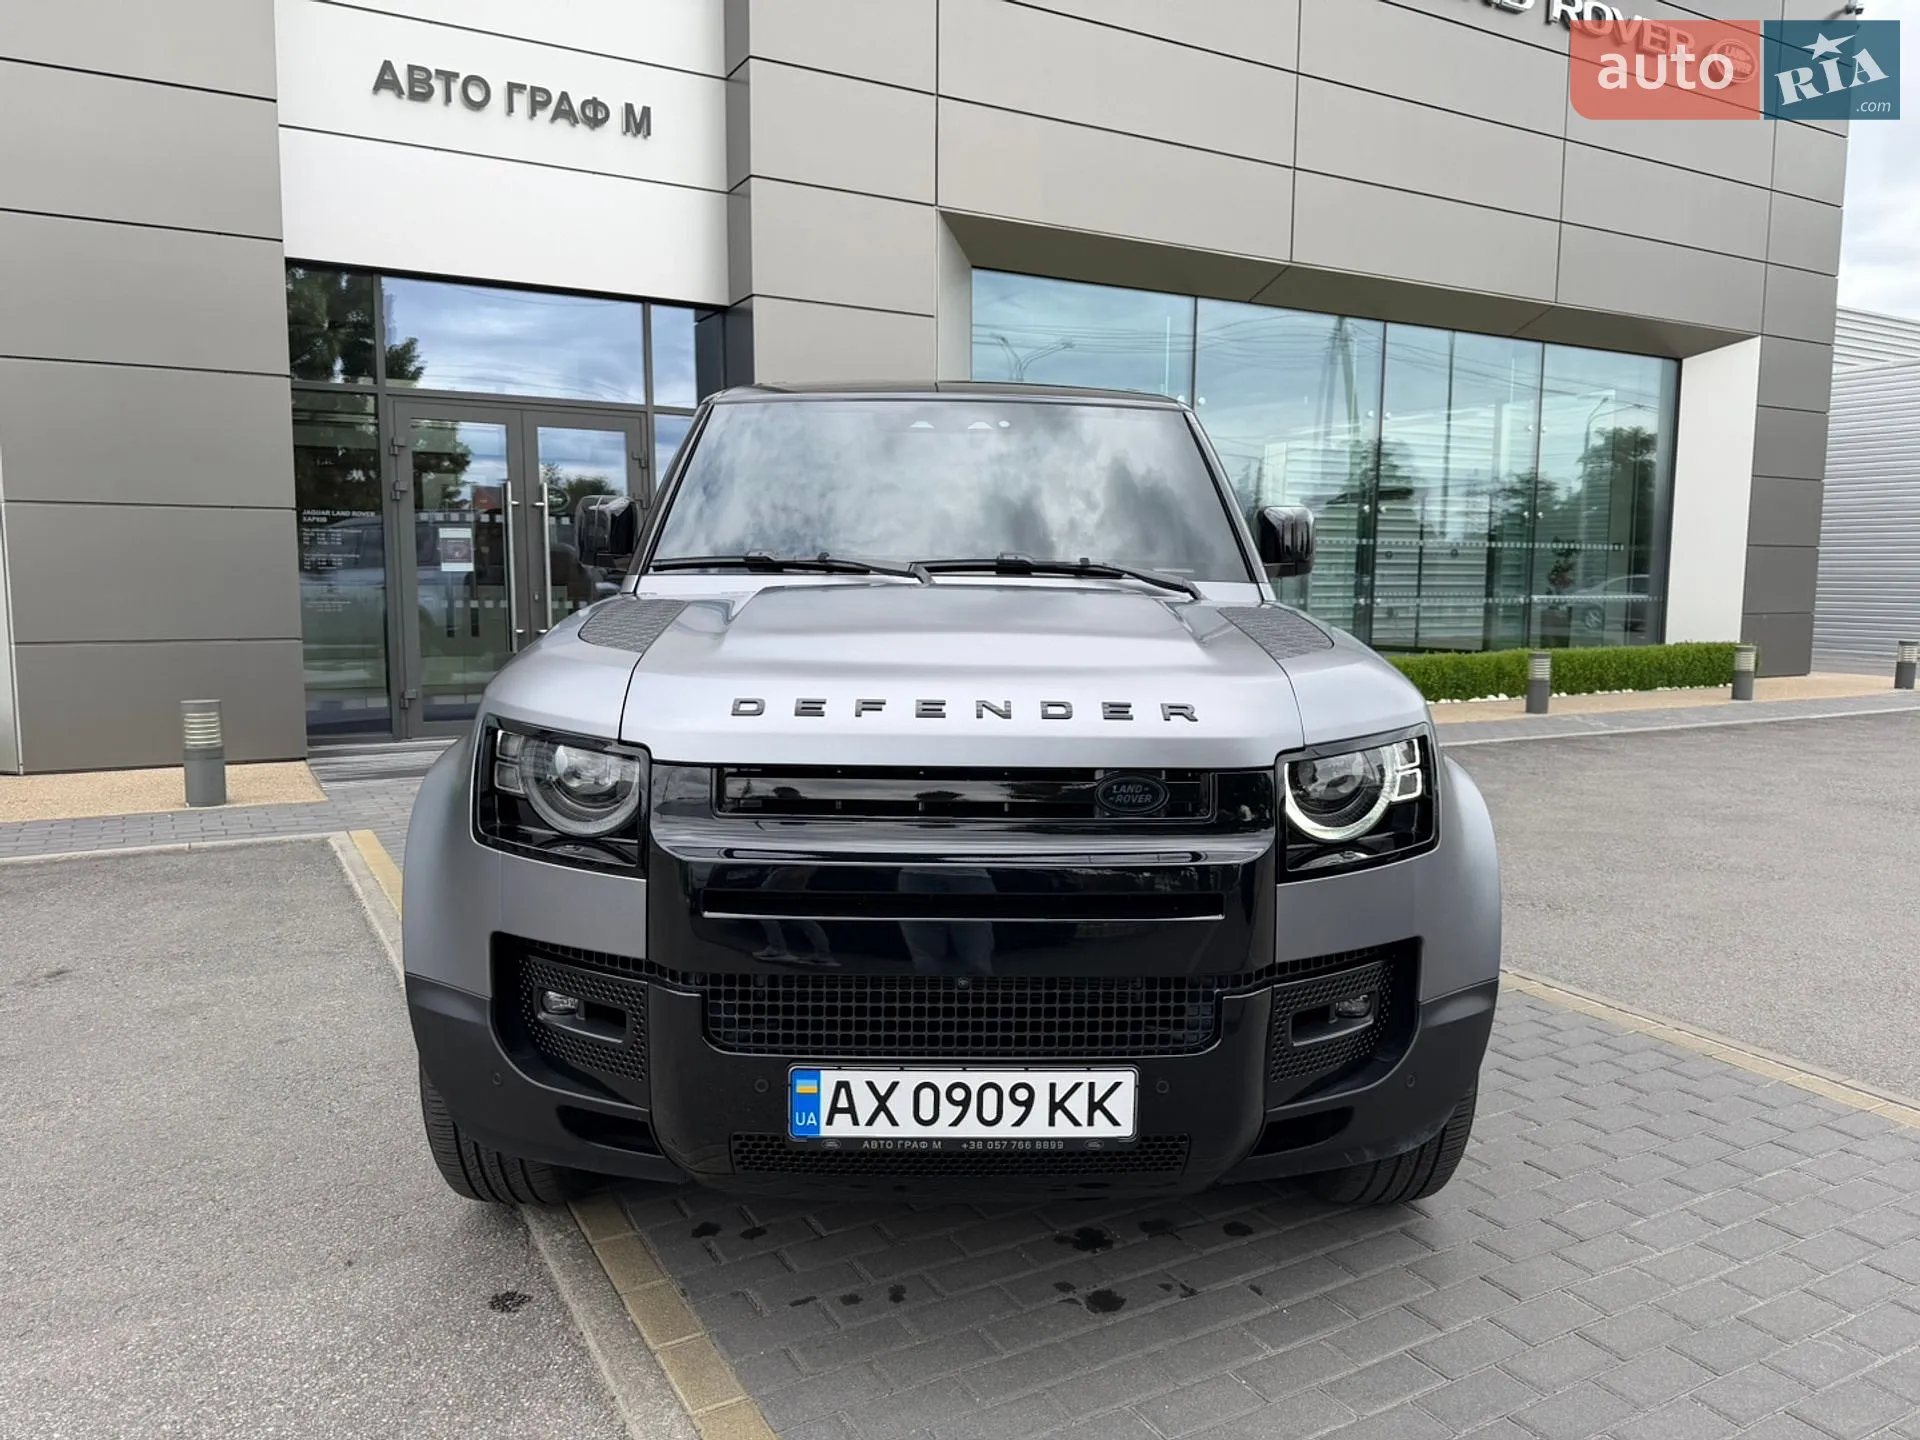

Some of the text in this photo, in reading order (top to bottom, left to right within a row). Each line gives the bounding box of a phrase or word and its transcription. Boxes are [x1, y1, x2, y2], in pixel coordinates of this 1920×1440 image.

[372, 59, 652, 139] АВТО ГРАФ М
[731, 697, 1198, 722] DEFENDER
[825, 1080, 1124, 1127] AX 0909 KK
[795, 1112, 817, 1126] UA
[862, 1140, 894, 1149] АВТО
[897, 1140, 928, 1149] ГРАФ
[987, 1141, 1008, 1149] 057
